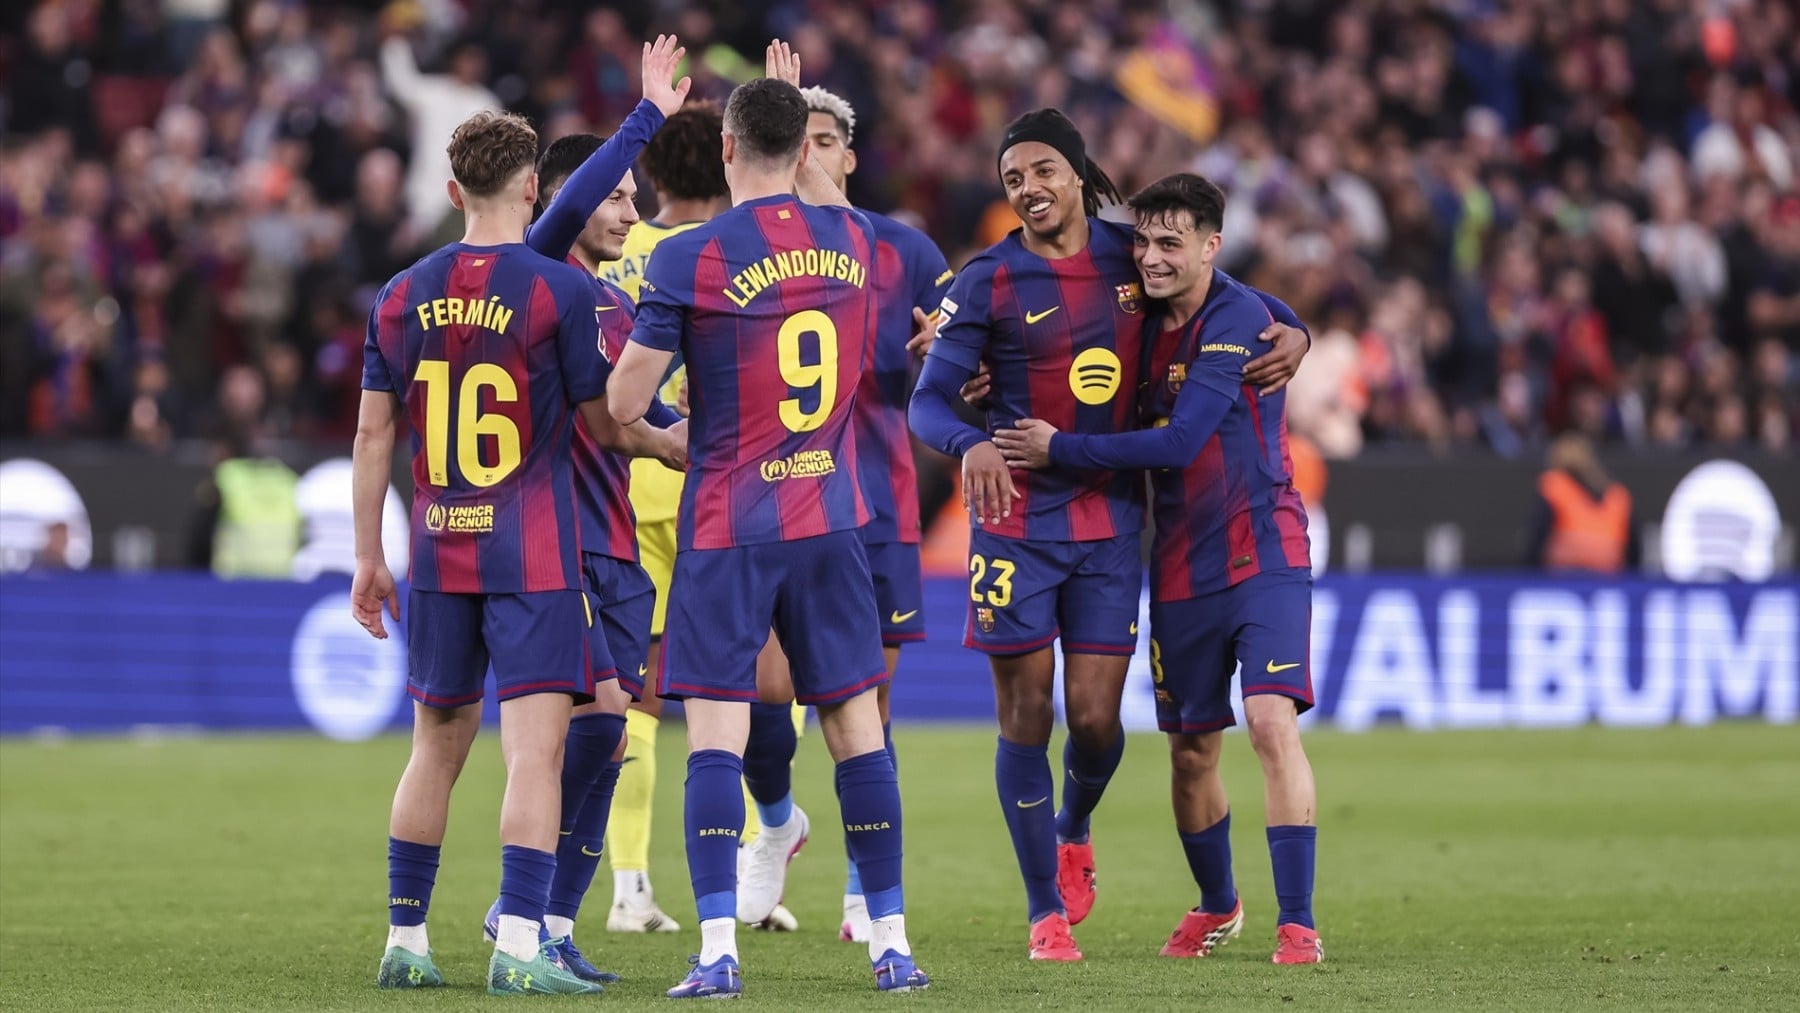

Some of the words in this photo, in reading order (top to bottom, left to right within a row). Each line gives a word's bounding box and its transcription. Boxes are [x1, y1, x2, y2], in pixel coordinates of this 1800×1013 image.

[722, 249, 866, 308] LEWANDOWSKI
[416, 295, 514, 335] FERMÍN
[777, 309, 838, 433] 9
[1201, 343, 1245, 355] AMBILIGHT
[414, 359, 522, 488] 16
[790, 459, 835, 474] ACNUR
[447, 516, 493, 528] ACNUR
[448, 505, 494, 517] UNHCR
[970, 554, 1016, 607] 23
[1332, 586, 1800, 731] ALBUM
